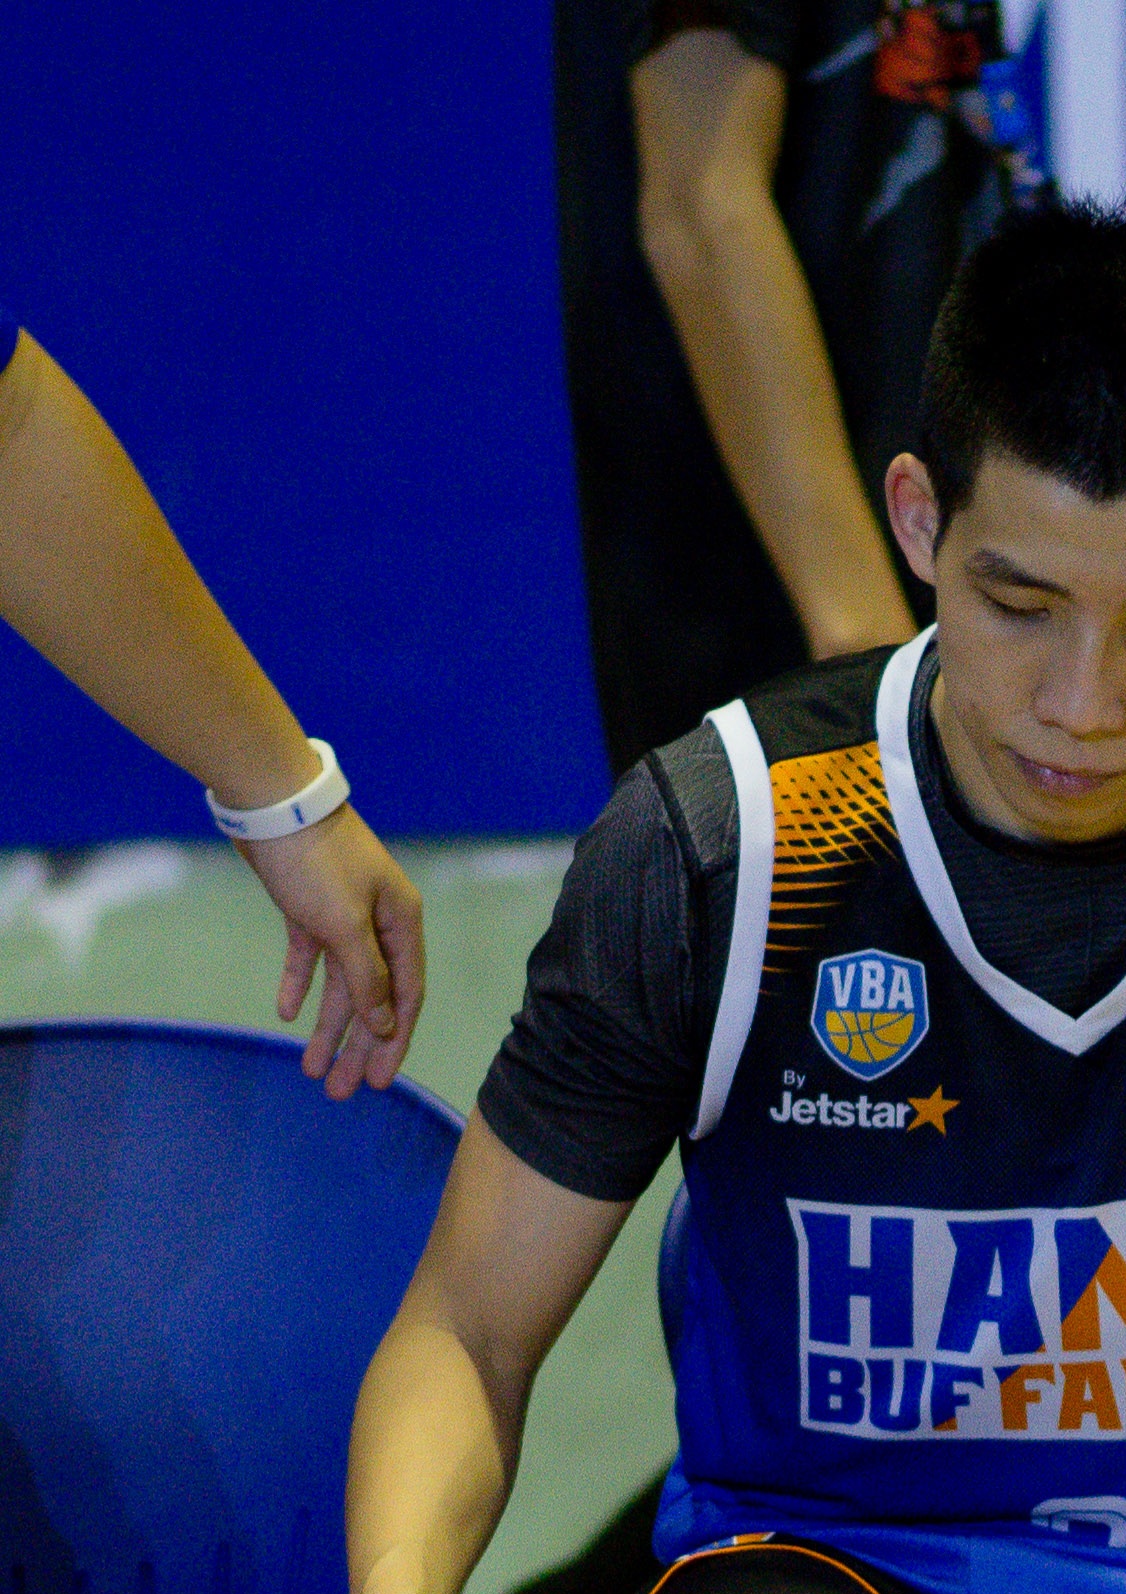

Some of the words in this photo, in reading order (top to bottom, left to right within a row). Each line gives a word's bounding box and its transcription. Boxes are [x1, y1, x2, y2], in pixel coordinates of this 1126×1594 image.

[828, 960, 915, 1009] VBA
[783, 1069, 806, 1088] By
[769, 1091, 912, 1129] Jetstar
